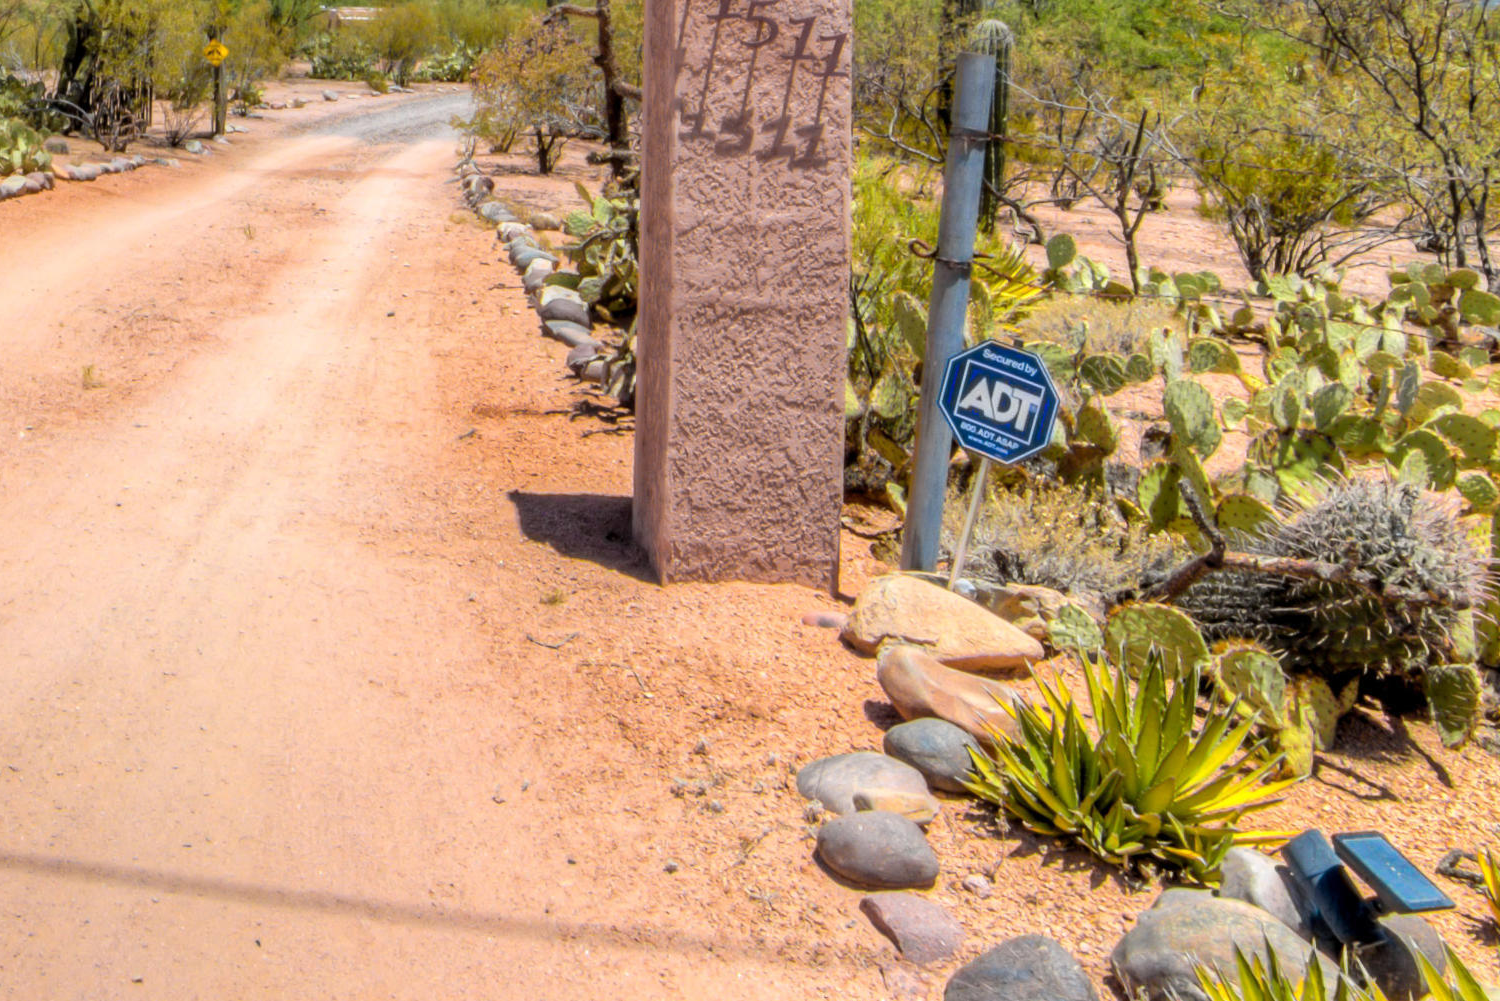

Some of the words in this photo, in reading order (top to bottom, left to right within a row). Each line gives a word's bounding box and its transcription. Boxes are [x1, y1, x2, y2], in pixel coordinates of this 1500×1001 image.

[982, 348, 1025, 371] Secured
[1025, 363, 1038, 377] by
[958, 376, 1041, 432] ADT
